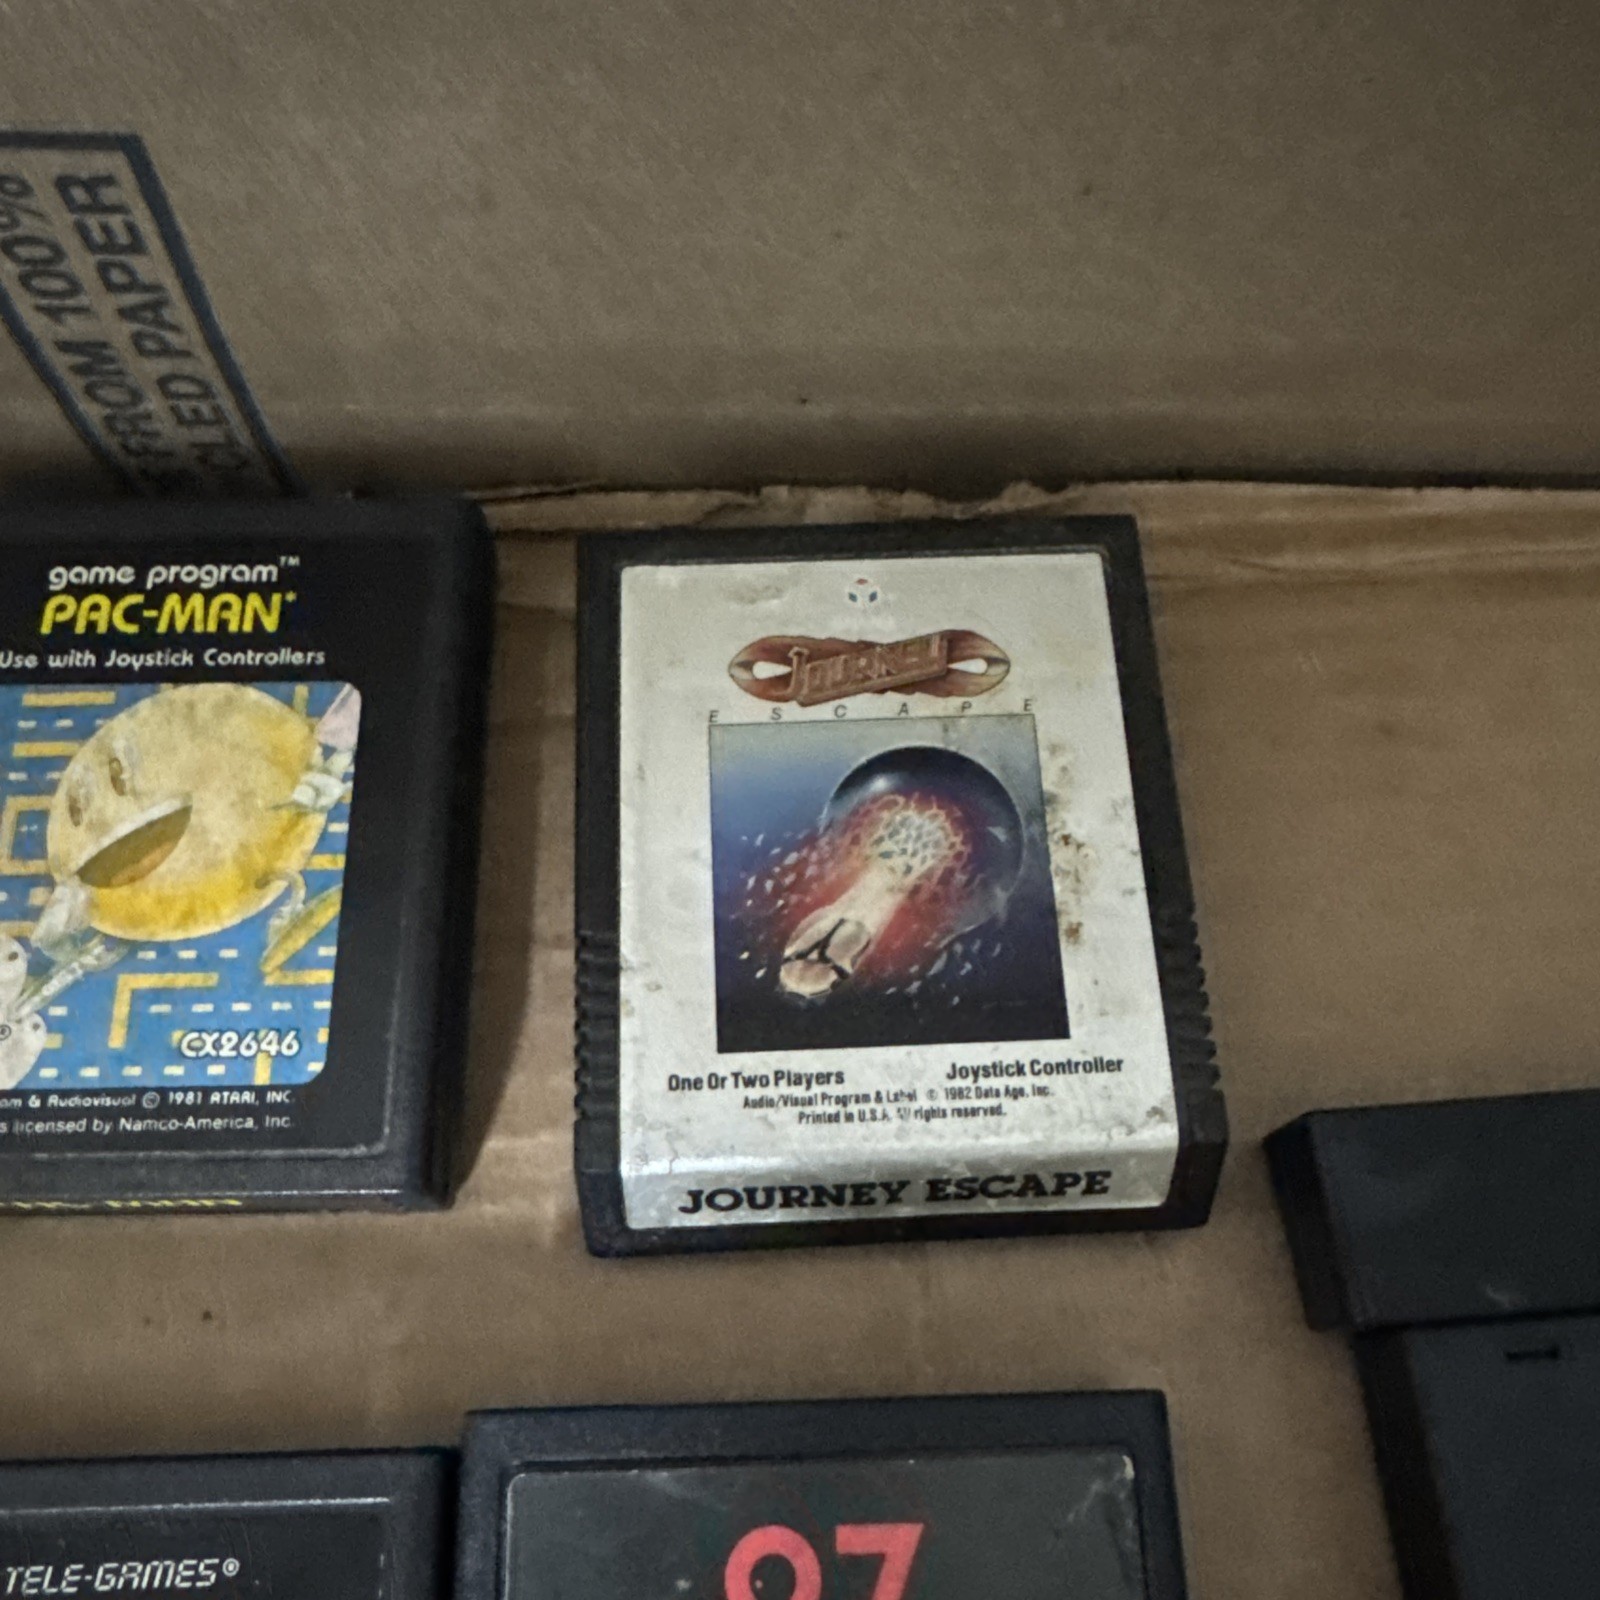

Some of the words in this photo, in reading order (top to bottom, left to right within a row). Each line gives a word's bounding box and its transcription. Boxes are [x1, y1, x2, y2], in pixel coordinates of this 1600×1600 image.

[0, 173, 96, 325] 100%
[55, 173, 193, 359] PAPER
[54, 340, 172, 458] FROM
[48, 564, 136, 591] game
[0, 649, 39, 669] Use
[48, 648, 97, 668] with
[105, 648, 194, 671] Joystick
[204, 647, 326, 667] Controllers
[180, 1030, 300, 1058] CX2646
[667, 1074, 703, 1092] One
[707, 1072, 729, 1089] Or
[731, 1070, 770, 1089] Two
[773, 1066, 846, 1090] Players
[945, 1060, 1027, 1083] Joystick
[1029, 1056, 1124, 1077] Controller
[28, 1094, 41, 1108] &
[48, 1093, 136, 1108] Audiovisual
[168, 1090, 202, 1106] 1981
[210, 1090, 259, 1106] ATARI,
[742, 1093, 818, 1110] Audio/Visual
[821, 1092, 871, 1108] Program
[874, 1090, 883, 1103] &
[944, 1086, 972, 1100] 1982
[975, 1086, 1001, 1100] Data
[1032, 1083, 1055, 1097] Inc.
[92, 1118, 113, 1134] by
[119, 1115, 258, 1132] Namco-America,
[798, 1109, 841, 1125] Printed
[844, 1109, 854, 1122] in
[914, 1105, 947, 1122] rights
[951, 1103, 1007, 1119] reserved.
[678, 1179, 911, 1215] JOURNEY
[925, 1170, 1112, 1203] ESCAPE
